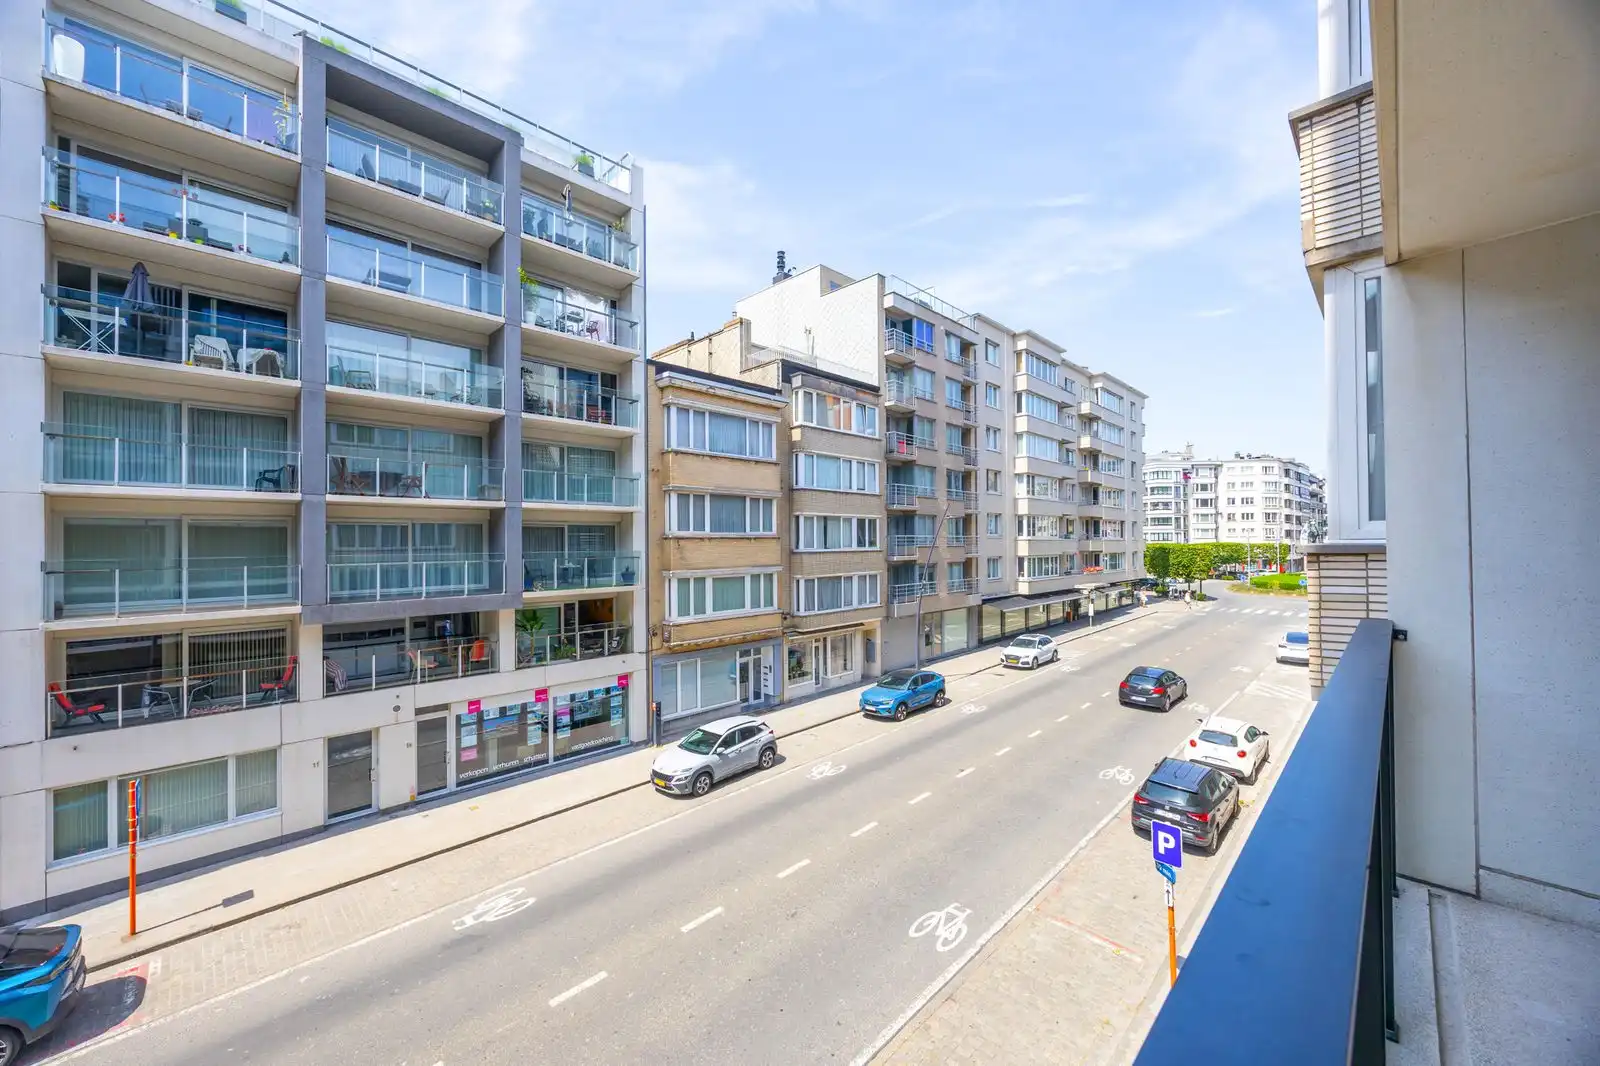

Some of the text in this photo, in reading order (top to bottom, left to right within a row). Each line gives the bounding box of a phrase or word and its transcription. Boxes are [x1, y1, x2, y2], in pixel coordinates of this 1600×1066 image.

[459, 767, 489, 778] verkopen
[493, 759, 519, 770] verhuren
[1158, 831, 1176, 855] P
